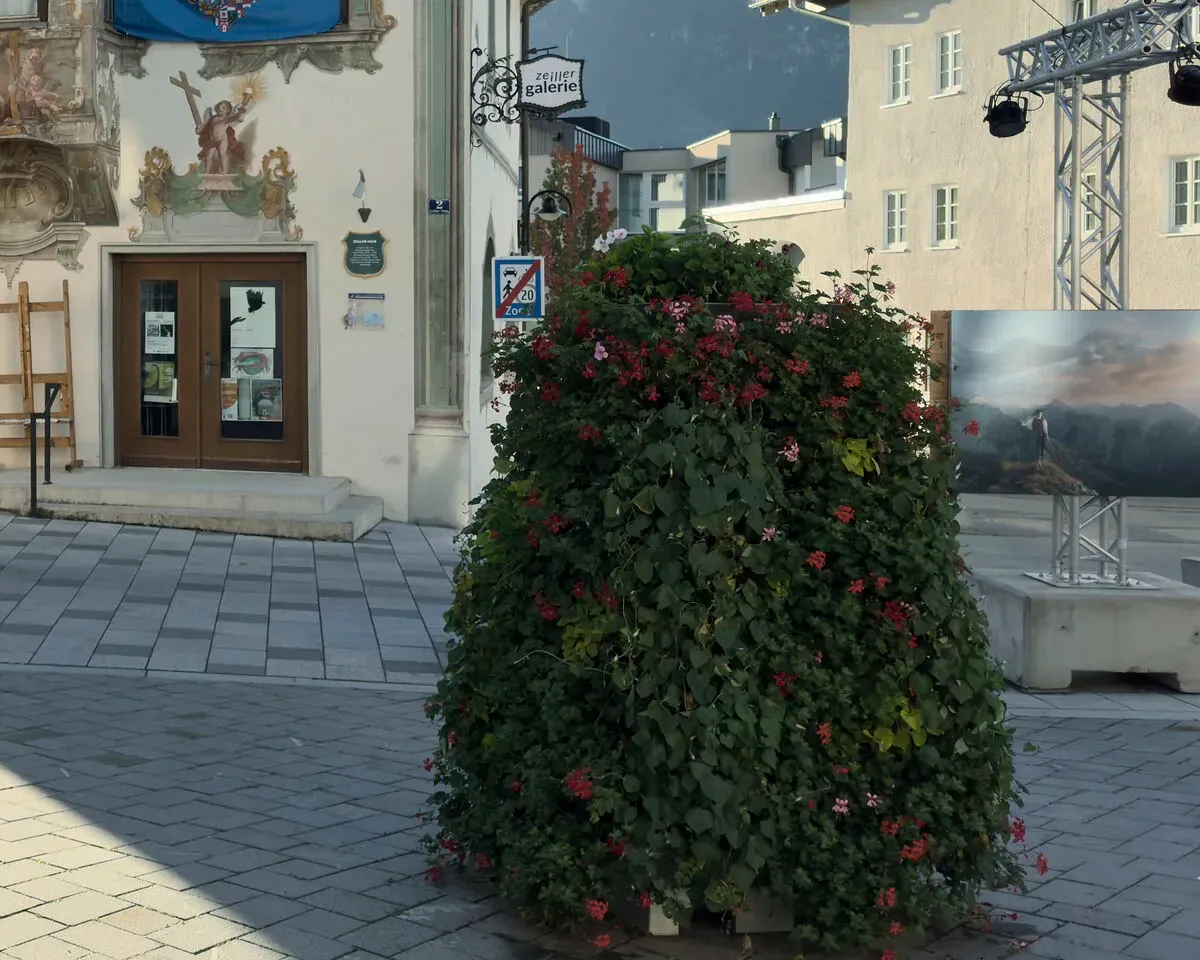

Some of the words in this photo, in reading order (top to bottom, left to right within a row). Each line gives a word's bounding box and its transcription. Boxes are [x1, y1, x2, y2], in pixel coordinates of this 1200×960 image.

[535, 69, 576, 82] zeiller
[525, 80, 578, 97] galerie
[435, 200, 443, 210] 2
[521, 289, 534, 301] 20
